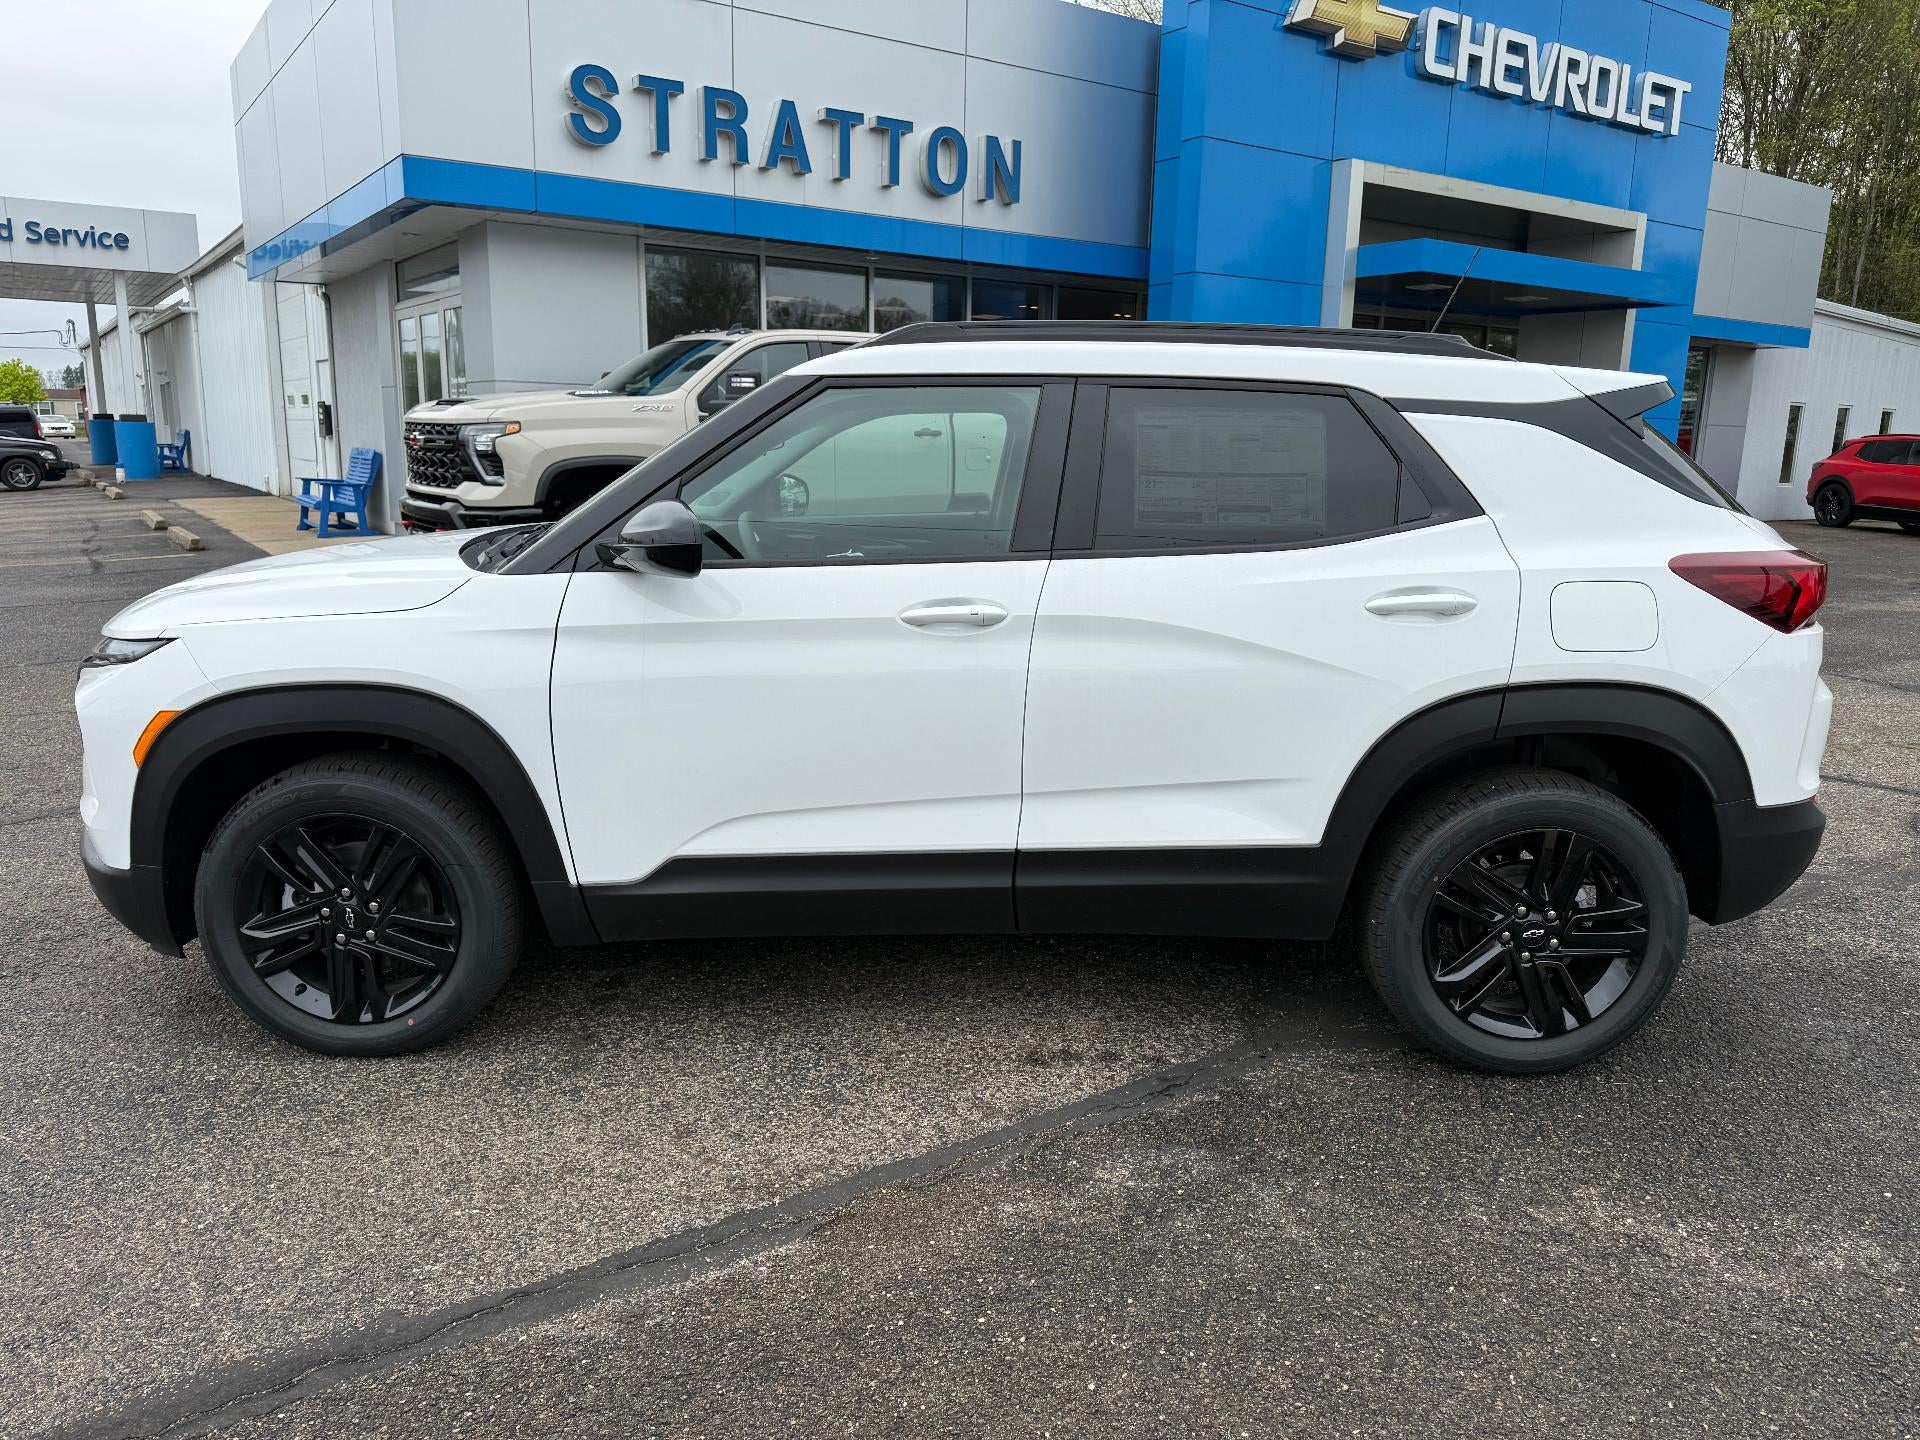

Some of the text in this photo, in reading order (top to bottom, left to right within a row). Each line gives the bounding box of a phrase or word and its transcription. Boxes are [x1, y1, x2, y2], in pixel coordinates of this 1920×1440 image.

[564, 63, 1023, 205] STRATTON
[1415, 6, 1692, 136] CHEVROLET
[25, 221, 130, 250] Service
